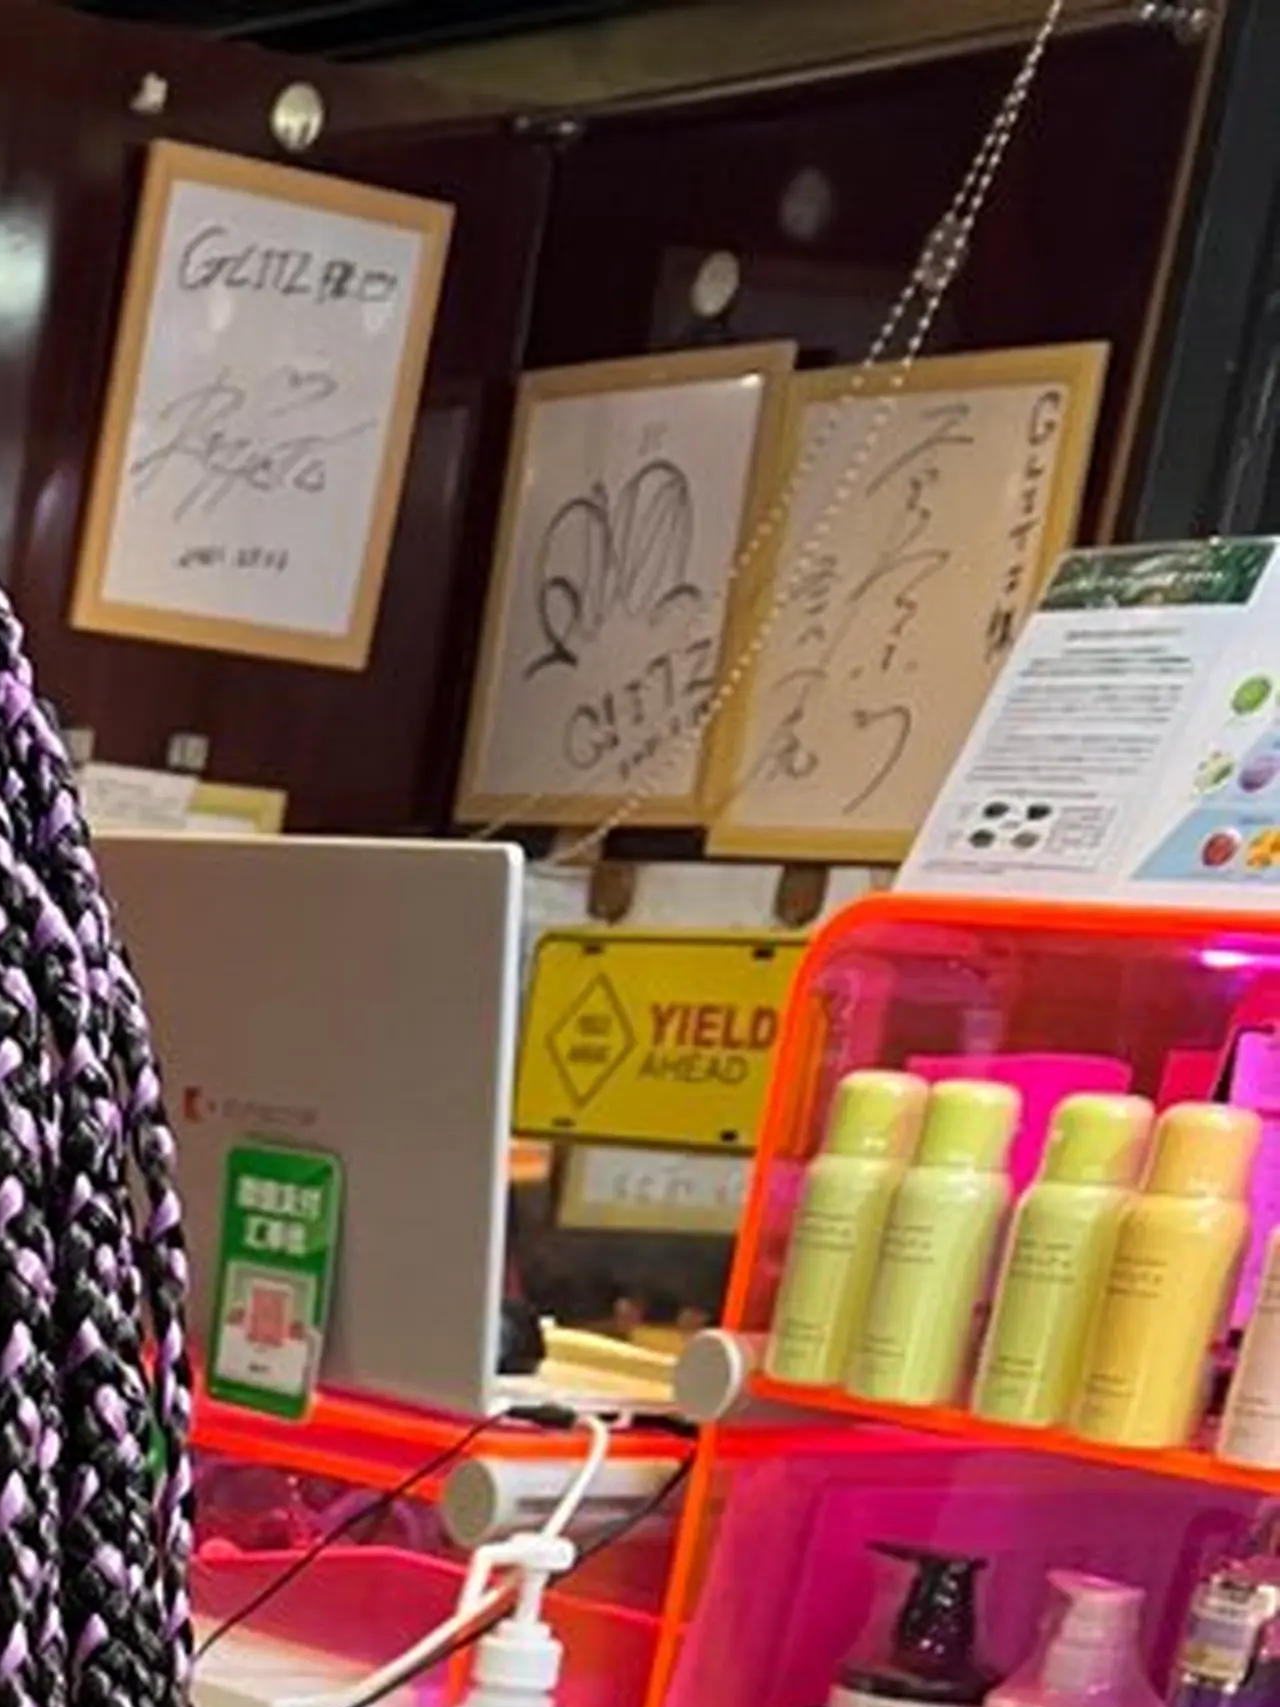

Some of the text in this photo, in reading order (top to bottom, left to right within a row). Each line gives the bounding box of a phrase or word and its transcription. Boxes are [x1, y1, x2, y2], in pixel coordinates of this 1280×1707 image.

[178, 226, 313, 294] GLITZ
[650, 1003, 778, 1051] YIELD
[639, 1050, 751, 1086] AHEAD
